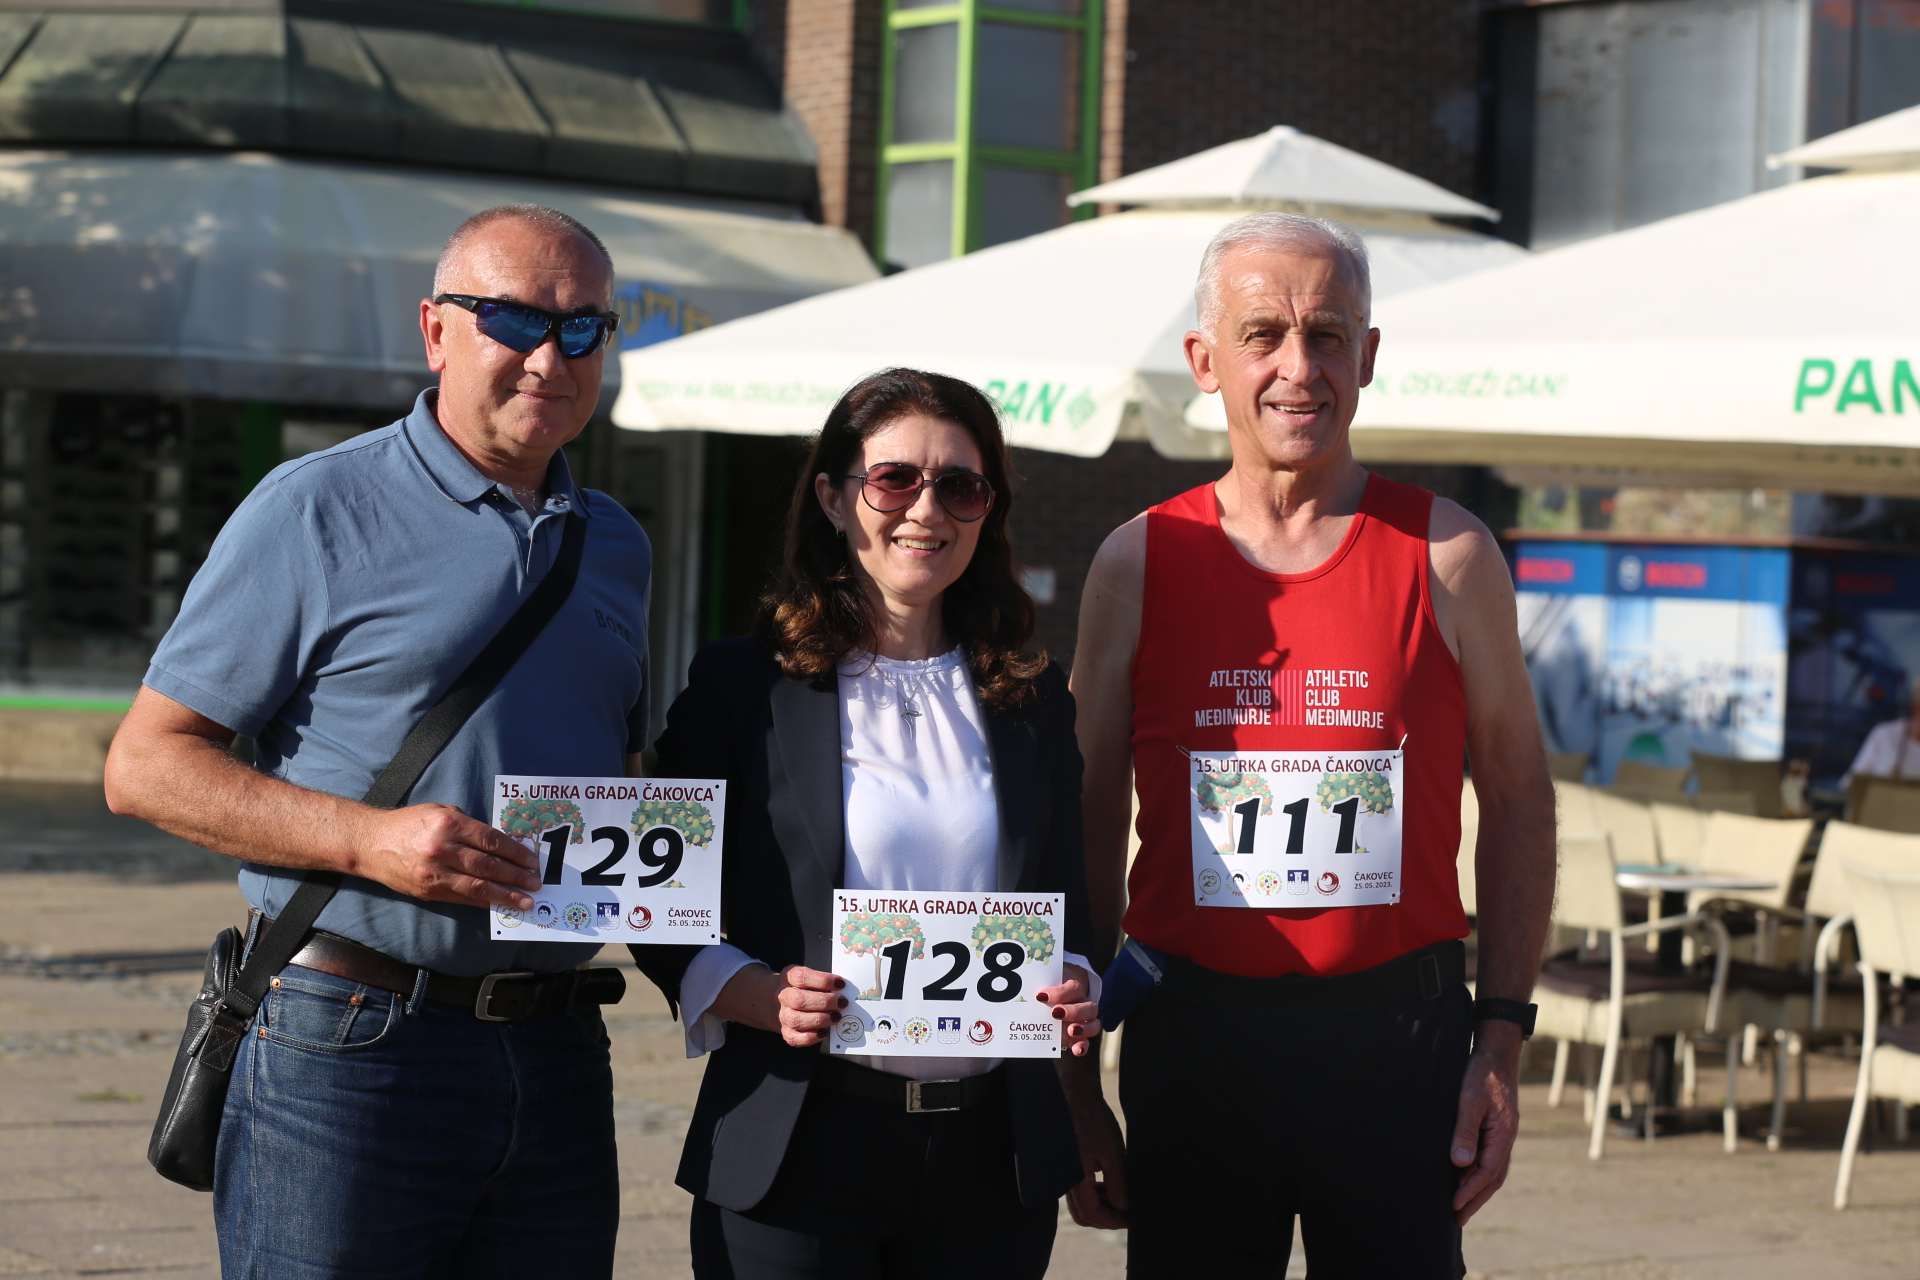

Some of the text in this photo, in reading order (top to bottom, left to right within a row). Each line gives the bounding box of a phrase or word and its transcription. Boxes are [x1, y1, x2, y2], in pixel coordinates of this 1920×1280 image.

[1209, 670, 1271, 687] ATLETSKI
[1305, 670, 1368, 688] ATHLETIC
[1236, 689, 1271, 706] KLUB
[1305, 689, 1340, 706] CLUB
[1195, 708, 1272, 727] MEĐIMURJE
[1305, 709, 1384, 729] MEĐIMURJE
[1197, 757, 1392, 773] 15. UTRKA GRADA ČAKOVCA
[502, 784, 713, 802] 15. UTRKA GRADA ČAKOVCA
[1234, 798, 1358, 854] 111
[541, 825, 684, 888] 129
[1354, 872, 1394, 881] ČAKOVEC
[1354, 882, 1393, 890] 25.05.2023.
[668, 908, 712, 919] ČAKOVEC
[840, 898, 1053, 916] 15. UTRKA GRADA ČAKOVCA
[668, 919, 712, 928] 25.05.2023.
[882, 940, 1026, 1003] 128
[1009, 1022, 1053, 1032] ČAKOVEC
[1009, 1033, 1053, 1041] 25.05.2023.
